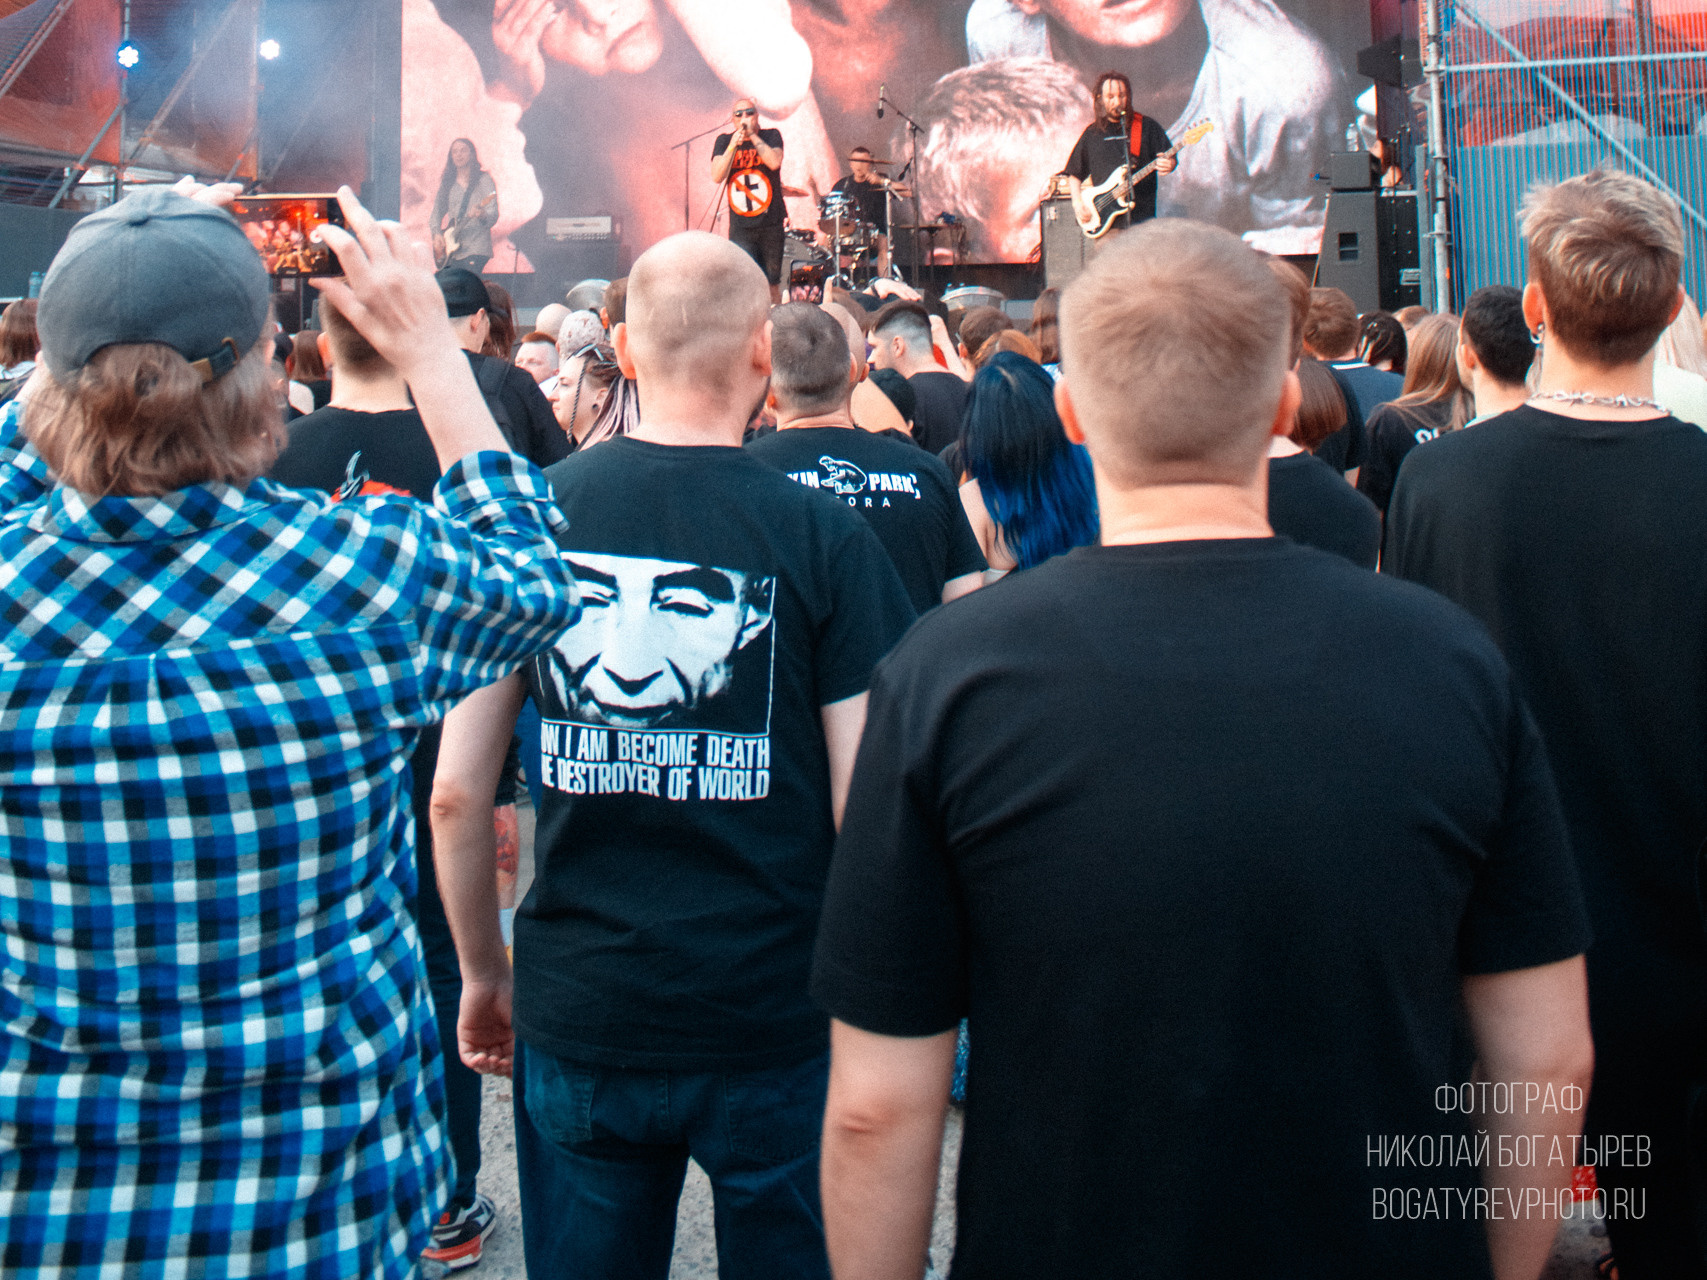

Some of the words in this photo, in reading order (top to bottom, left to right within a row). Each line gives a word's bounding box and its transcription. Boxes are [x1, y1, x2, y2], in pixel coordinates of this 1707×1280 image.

[868, 473, 915, 494] PARK
[836, 495, 891, 507] ORA
[565, 725, 573, 759] I
[576, 728, 609, 761] AM
[617, 731, 698, 767] BECOME
[706, 734, 770, 769] DEATH
[557, 757, 660, 798] DESTROYER
[667, 766, 692, 801] OF
[698, 766, 769, 801] WORLD
